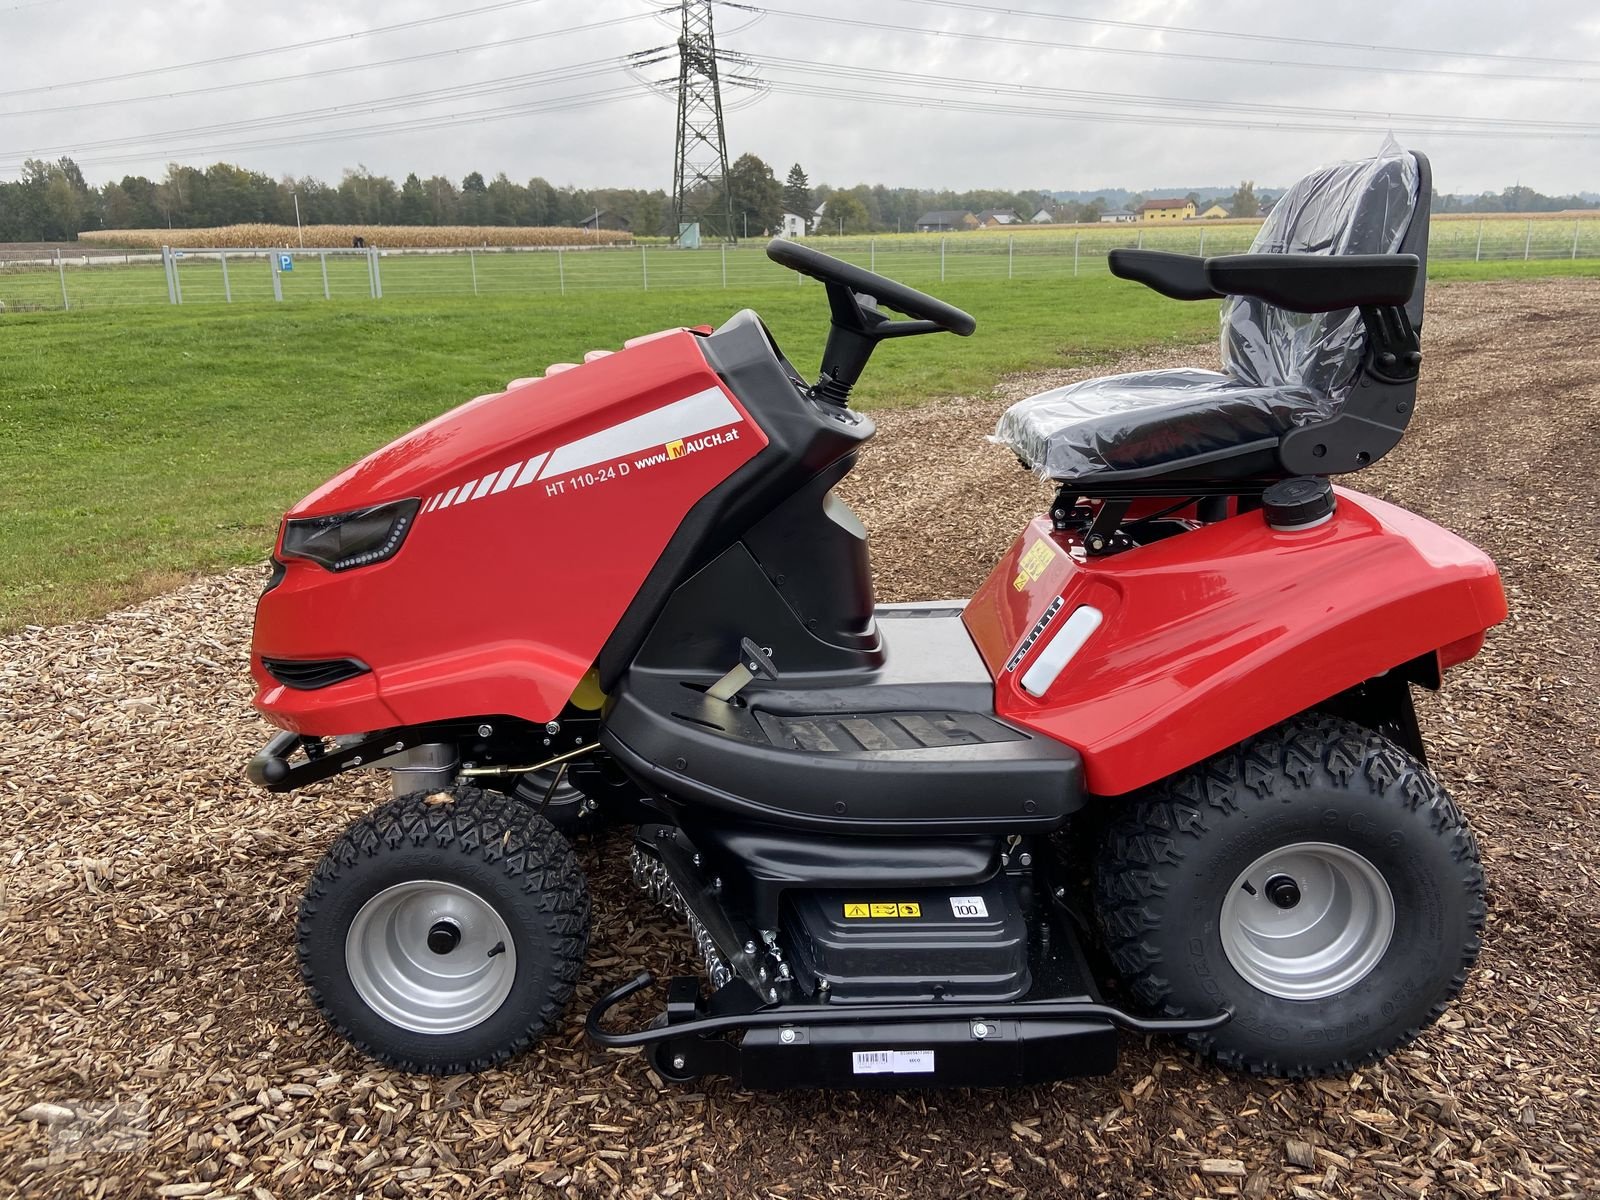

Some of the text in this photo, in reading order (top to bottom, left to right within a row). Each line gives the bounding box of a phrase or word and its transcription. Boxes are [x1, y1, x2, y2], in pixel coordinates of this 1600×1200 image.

[281, 255, 290, 270] P
[634, 428, 740, 470] www.MAUCH.at
[545, 462, 631, 497] HT 110-24 D
[954, 904, 978, 915] 100
